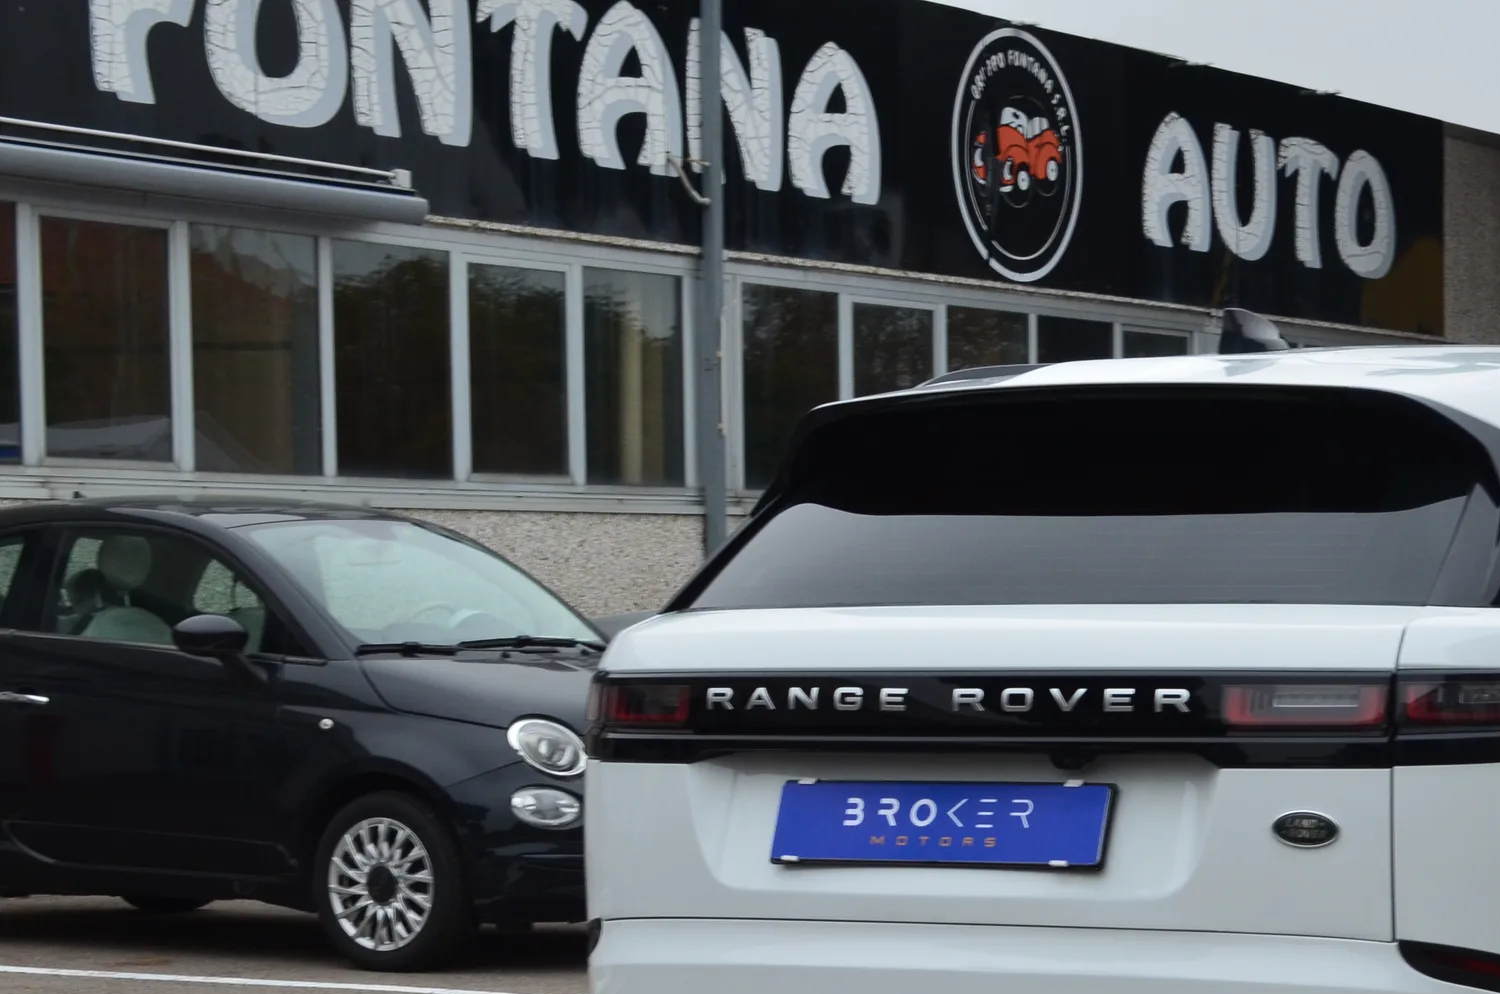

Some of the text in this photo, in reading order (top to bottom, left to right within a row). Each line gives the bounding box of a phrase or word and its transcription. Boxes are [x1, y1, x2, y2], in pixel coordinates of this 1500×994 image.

[88, 0, 1396, 279] FONTANA AUTO
[705, 686, 1191, 714] RANGE ROVER
[842, 797, 1035, 829] BROKER
[868, 835, 998, 848] MOTORS
